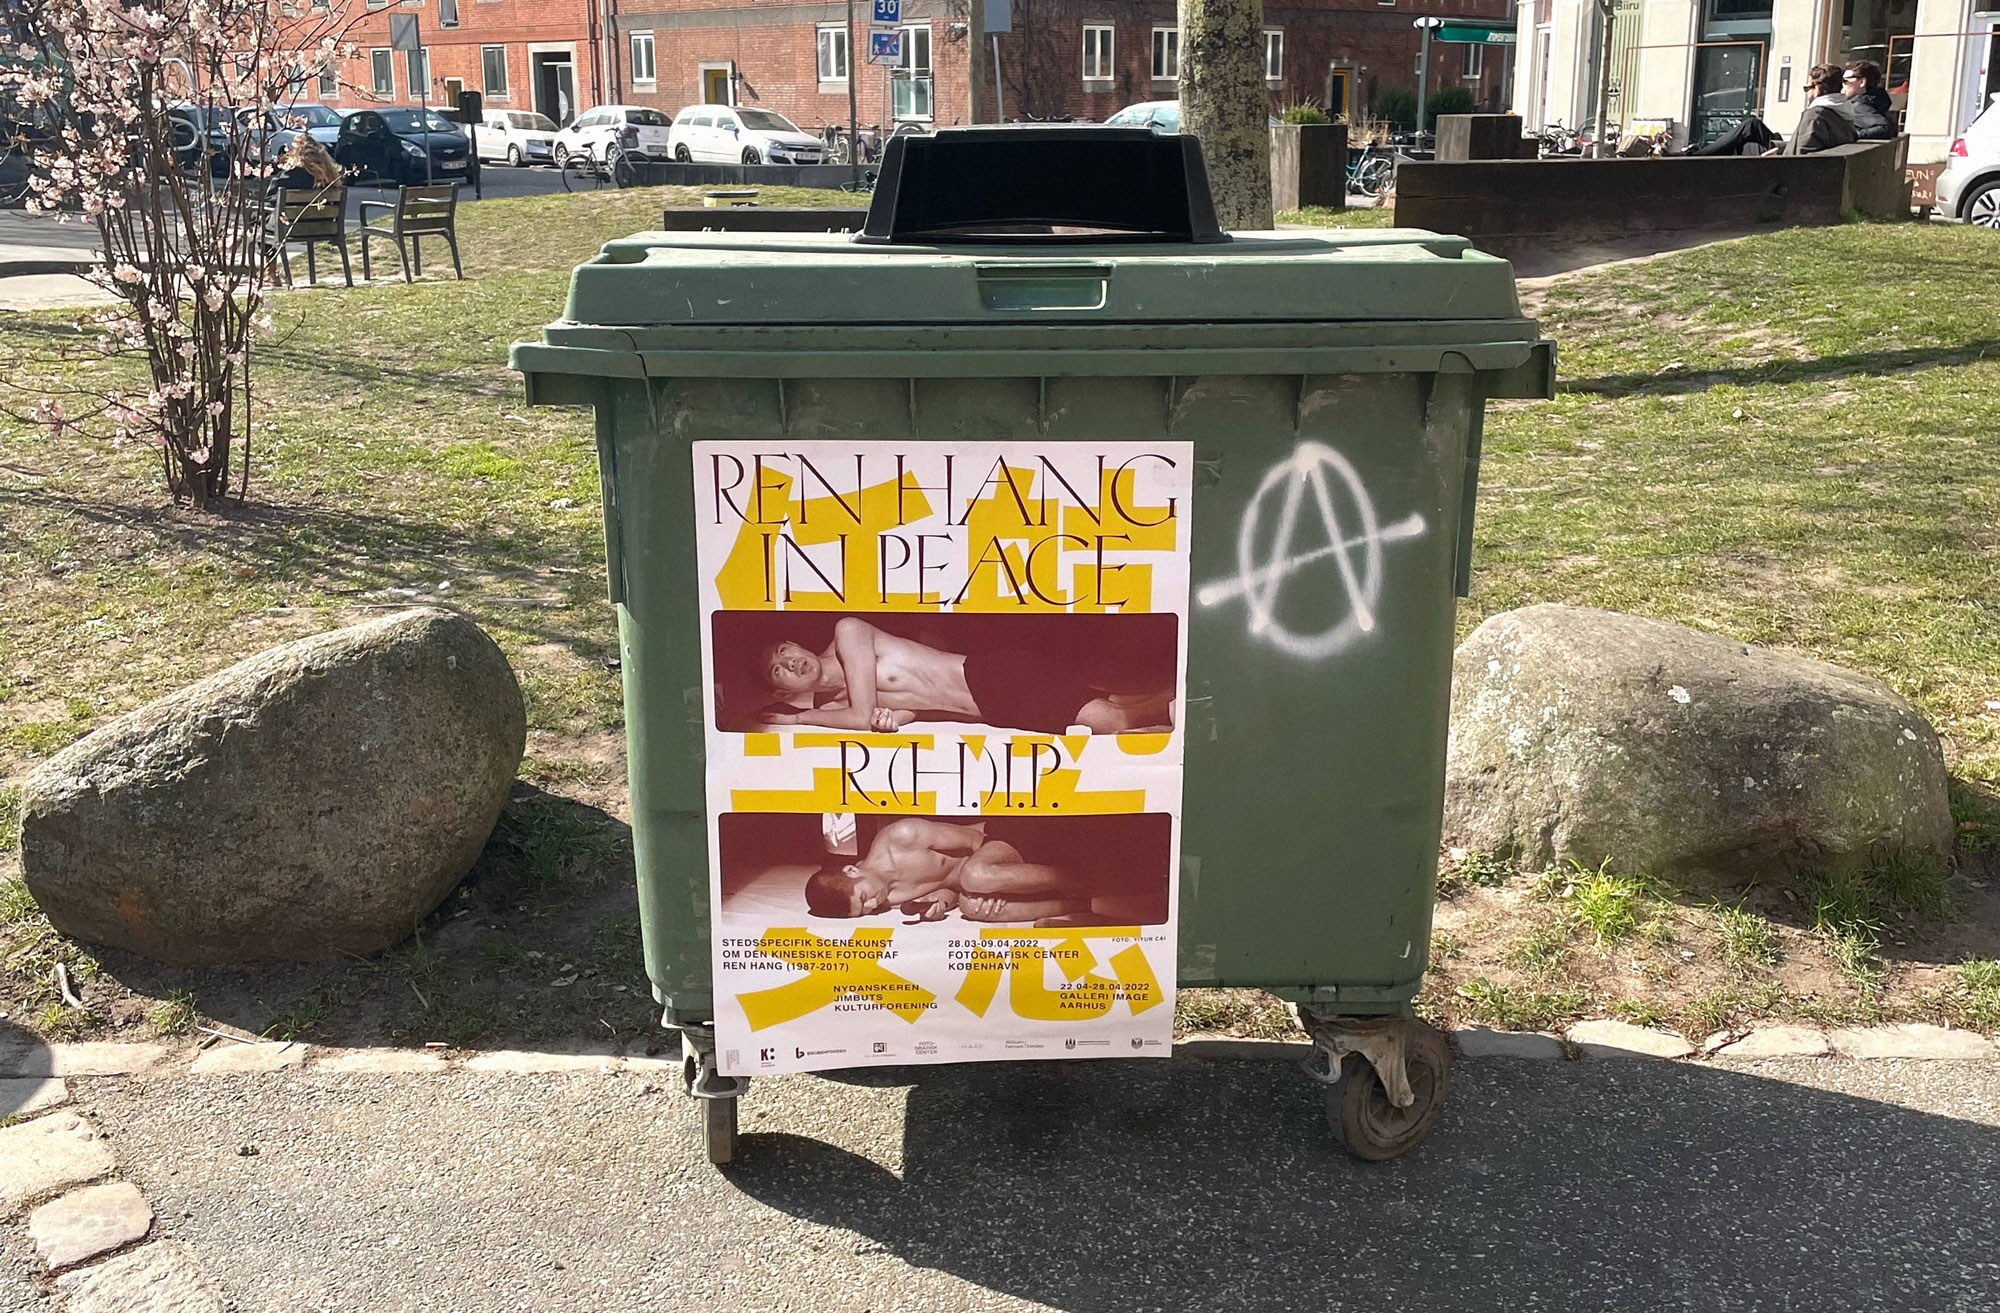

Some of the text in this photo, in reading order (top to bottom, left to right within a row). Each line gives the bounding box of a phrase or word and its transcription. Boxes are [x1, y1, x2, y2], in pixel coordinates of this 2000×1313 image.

[877, 0, 897, 14] 30
[710, 452, 1178, 527] REN HANG
[760, 532, 1133, 608] IN PEACE
[722, 938, 894, 948] STEDSSPECIFIK SCENEKUNST
[948, 939, 1039, 948] 28.03-09.04.2022
[722, 950, 899, 960] OM DEN KINESISKE FOTOGRAF
[948, 950, 1080, 960] FOTOGRAFISK CENTER
[723, 961, 850, 973] REN HANG (1987-2017)
[948, 962, 1020, 971] KØBENHAVN
[833, 984, 919, 993] NYDANSKEREN
[1060, 983, 1150, 991] 22.04-28.04.2022
[834, 994, 884, 1002] JIMBUTS
[1060, 992, 1149, 1001] GALLERI IMAGE
[834, 1002, 938, 1012] KULTURFORENING
[1059, 1001, 1107, 1010] AARHUS
